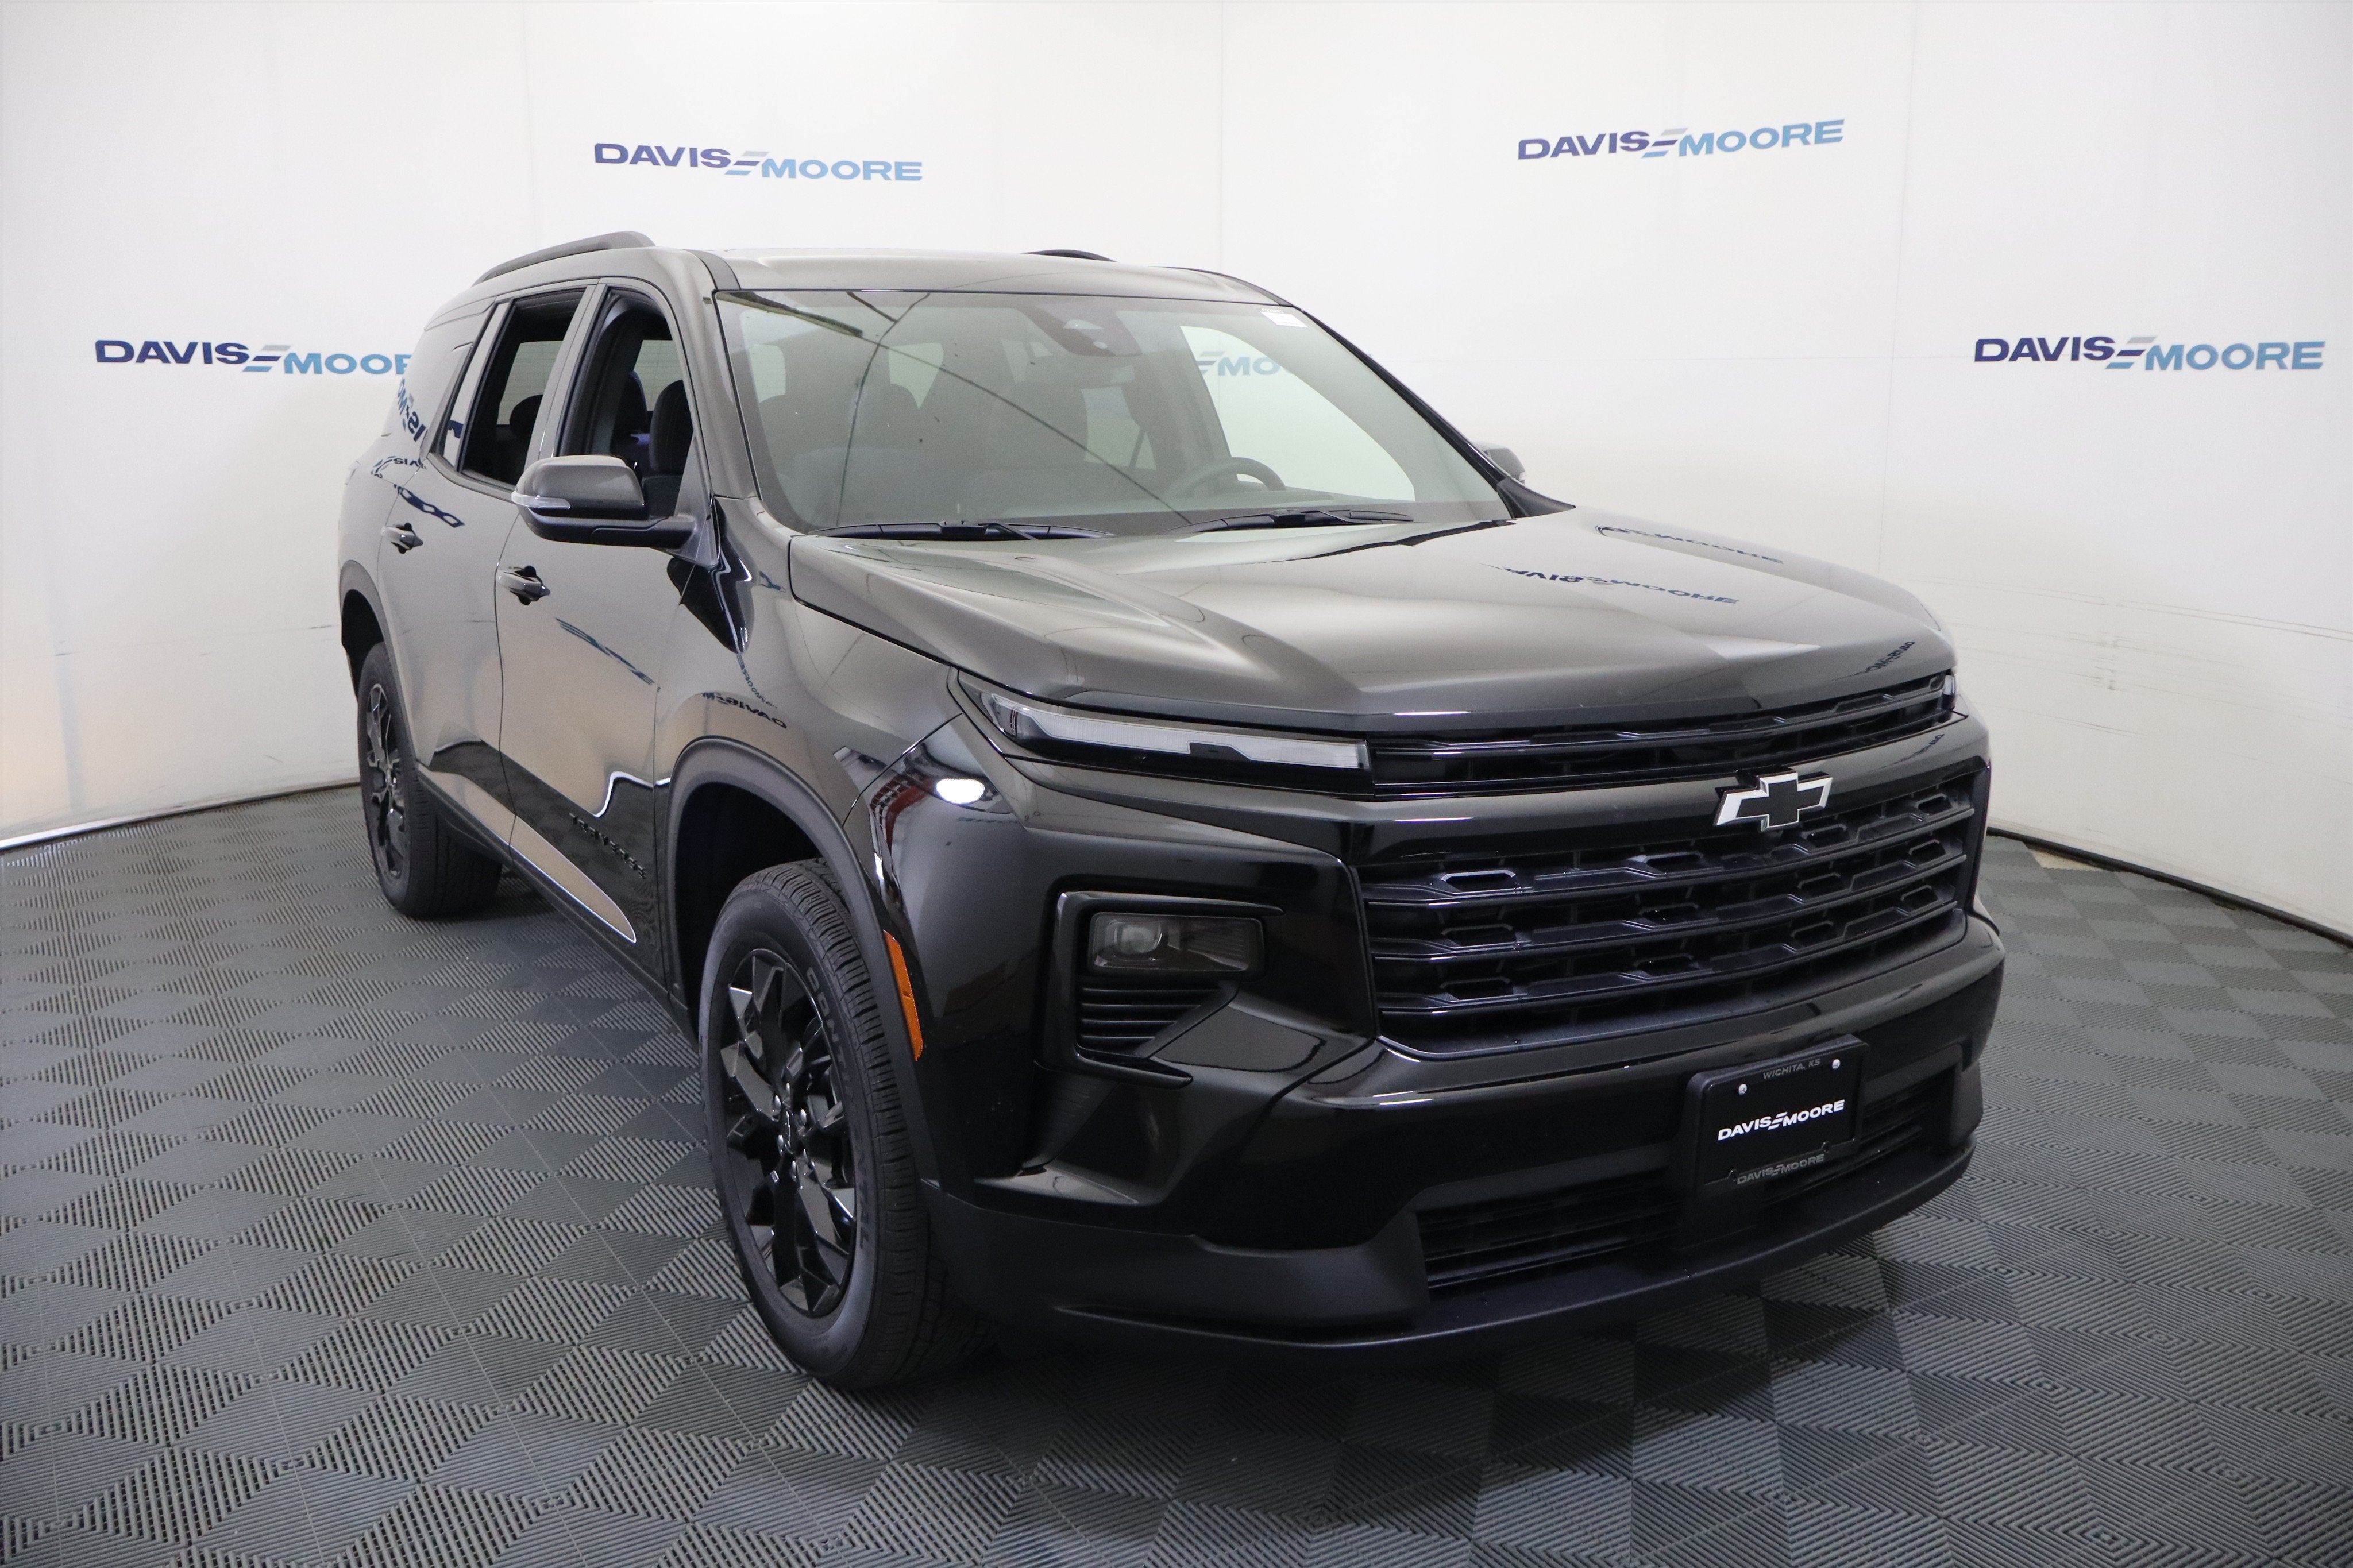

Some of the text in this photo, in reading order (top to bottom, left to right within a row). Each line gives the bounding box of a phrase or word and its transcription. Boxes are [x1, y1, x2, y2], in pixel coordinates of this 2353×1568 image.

[1518, 119, 1845, 160] DAVIS MOORE
[595, 142, 923, 181] DAVIS MOORE
[95, 339, 412, 375] DAVIS MOO
[1974, 335, 2325, 370] DAVIS MOORE
[1808, 1059, 1820, 1068] KS
[1718, 1099, 1845, 1141] DAVIS MOORE
[1737, 1153, 1825, 1185] DAVIS MOORE
